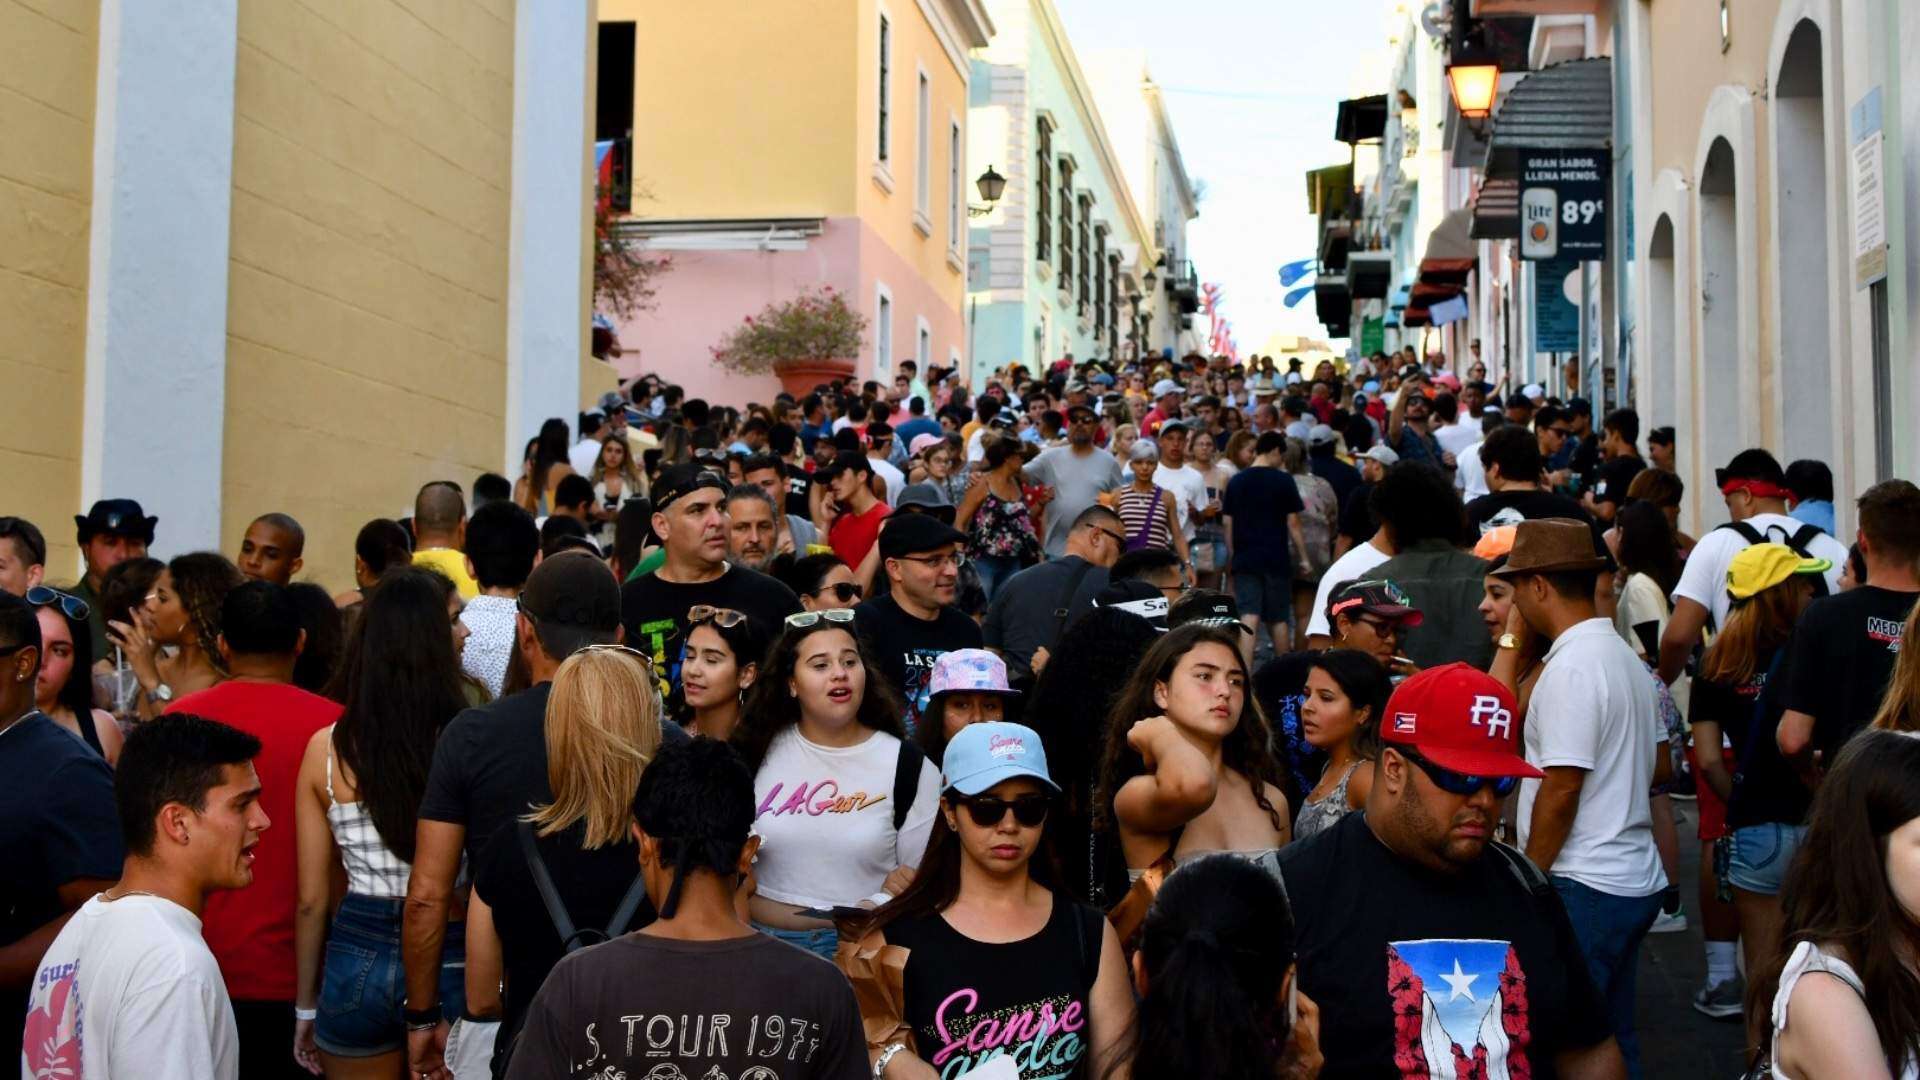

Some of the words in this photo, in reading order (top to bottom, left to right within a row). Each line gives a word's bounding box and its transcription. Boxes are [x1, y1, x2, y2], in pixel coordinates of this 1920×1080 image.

[1528, 158, 1557, 168] GRAN
[1559, 158, 1597, 168] SABOR.
[1525, 171, 1558, 181] LLENA
[1560, 171, 1600, 181] MENOS.
[1527, 205, 1552, 221] Lite
[904, 653, 924, 666] LA
[932, 988, 1085, 1065] Sanse
[620, 1014, 732, 1057] TOUR
